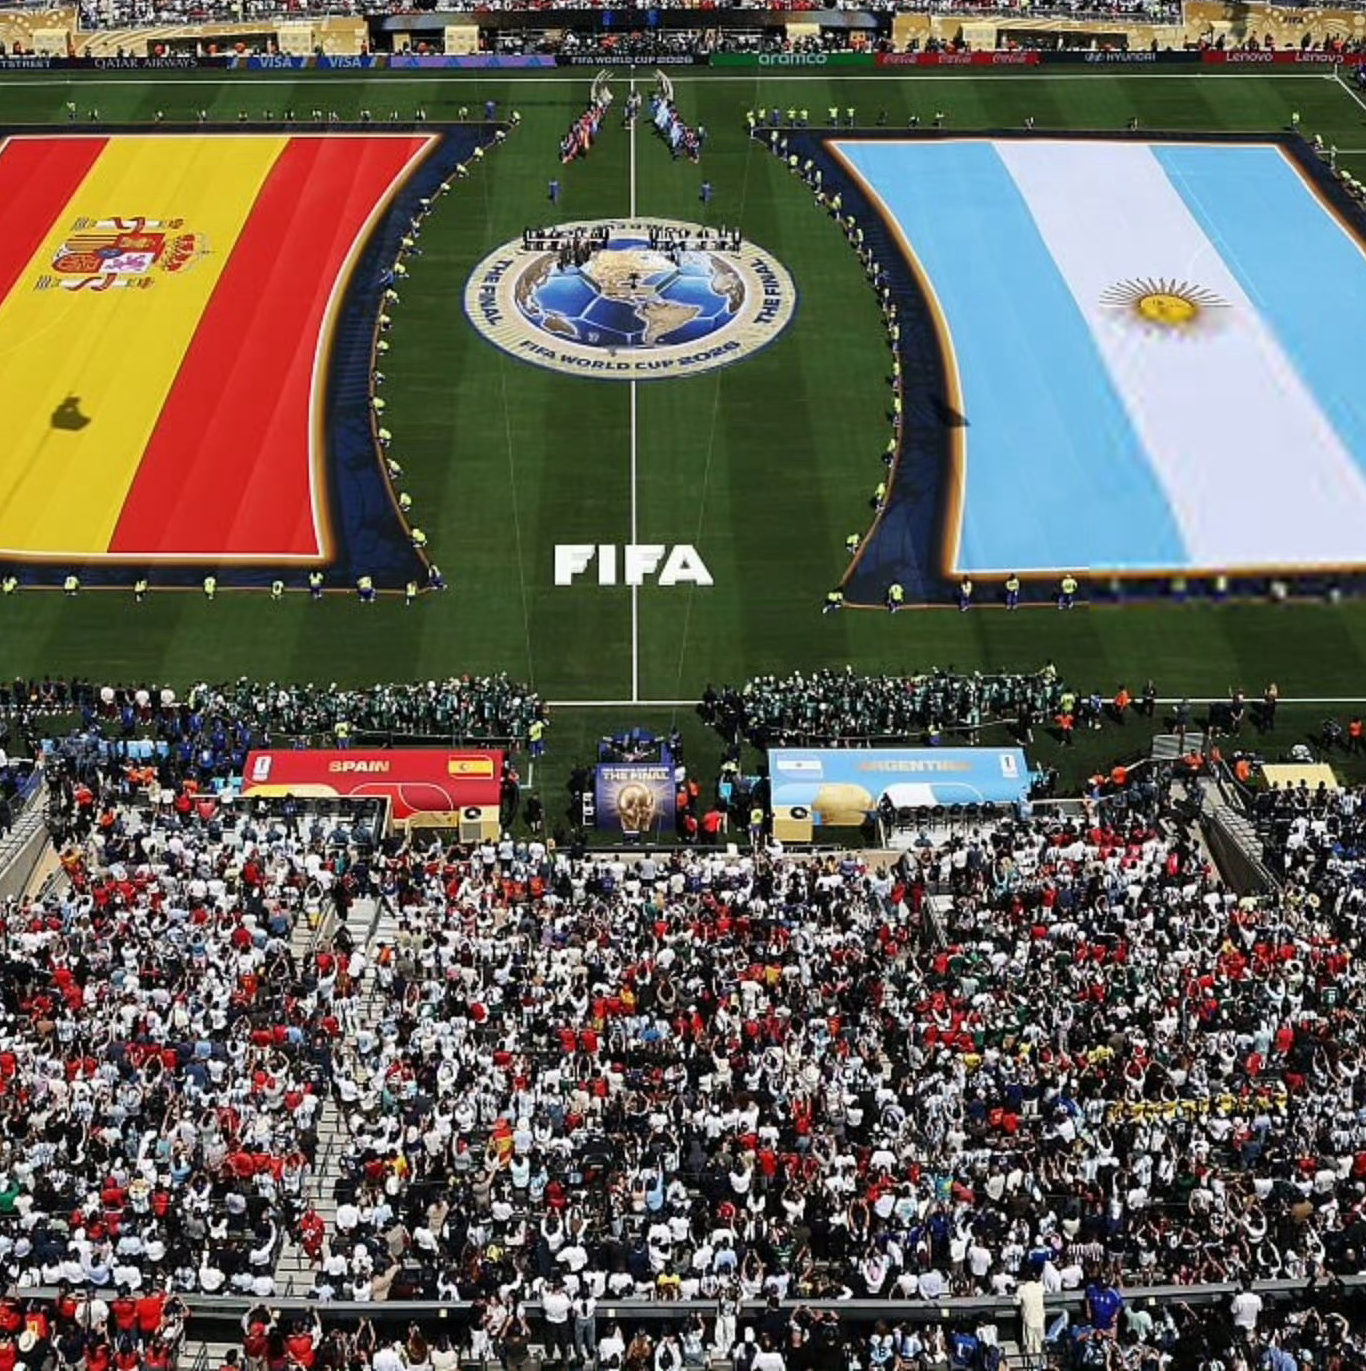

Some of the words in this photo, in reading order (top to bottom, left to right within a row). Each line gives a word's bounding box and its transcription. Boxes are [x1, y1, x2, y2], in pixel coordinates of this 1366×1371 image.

[94, 58, 138, 70] QATAR
[142, 57, 198, 69] AIRWAYS
[259, 56, 292, 67] VISA
[329, 56, 362, 67] VISA
[571, 56, 593, 65] FIFA
[595, 56, 633, 65] WORLD
[635, 56, 656, 65] CUP
[759, 53, 827, 66] aramco
[1226, 51, 1273, 63] Lenovo
[486, 259, 513, 287] THE
[752, 258, 782, 297] FINAL
[476, 285, 505, 326] FINAL
[753, 296, 781, 325] THE
[519, 339, 556, 360] FIFA
[560, 353, 631, 371] WORLD
[634, 359, 674, 371] CUP
[677, 340, 742, 368] 2026
[554, 544, 715, 586] FIFA
[328, 760, 390, 773] SPAIN
[603, 772, 628, 780] THE
[630, 771, 670, 781] FINAL
